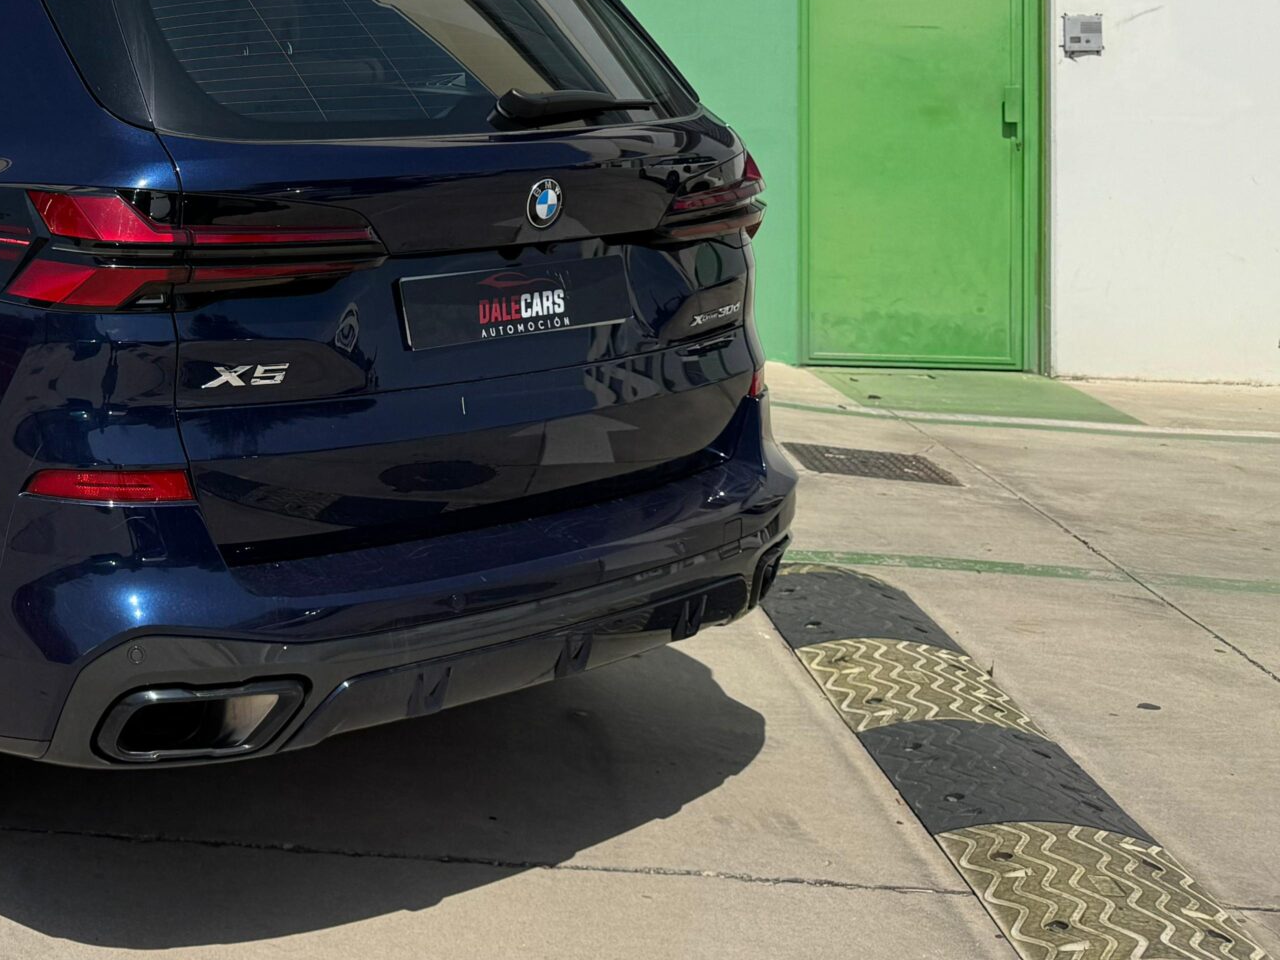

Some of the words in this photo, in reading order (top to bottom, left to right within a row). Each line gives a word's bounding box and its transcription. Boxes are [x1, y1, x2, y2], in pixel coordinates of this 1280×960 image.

[479, 289, 565, 324] DALECARS
[481, 316, 570, 338] AUTOMOCIÓN
[201, 362, 290, 389] X5
